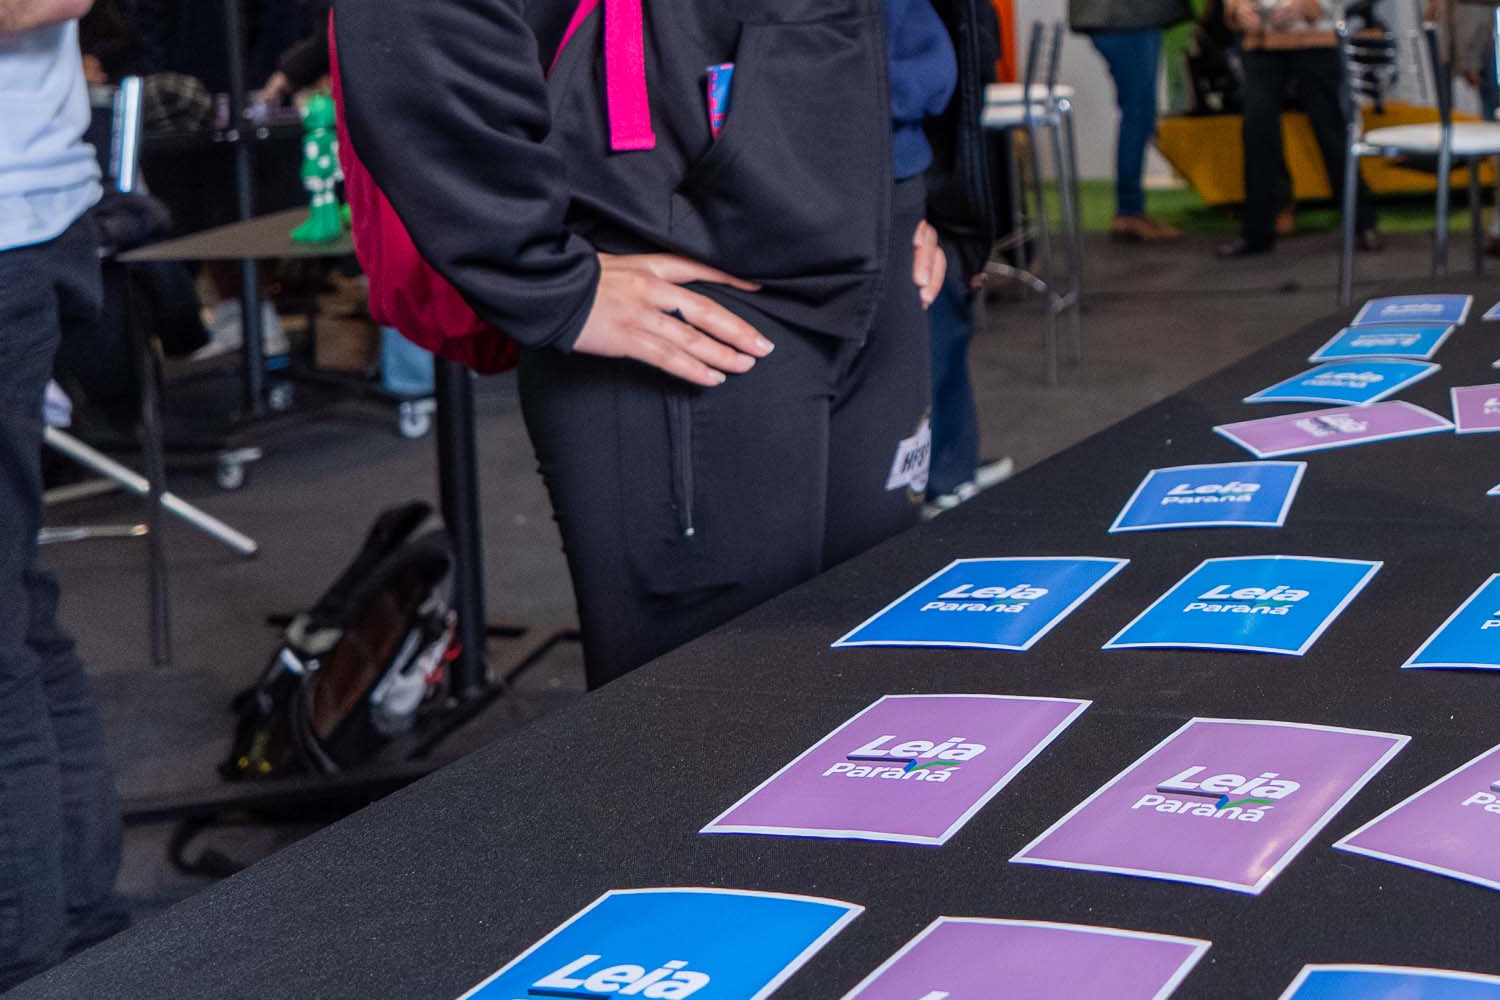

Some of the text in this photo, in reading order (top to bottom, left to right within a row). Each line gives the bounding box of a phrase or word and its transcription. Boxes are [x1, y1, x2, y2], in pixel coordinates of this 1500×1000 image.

[1167, 481, 1261, 495] Leia
[937, 584, 1049, 600] Leia
[1197, 584, 1310, 602] Leia
[919, 601, 1031, 613] Paraná
[1183, 602, 1294, 616] Paraná
[848, 735, 987, 761] Leia
[822, 762, 961, 782] Paraná
[1157, 765, 1301, 799] Leia
[1131, 794, 1276, 823] Paraná
[531, 954, 711, 1000] Leia
